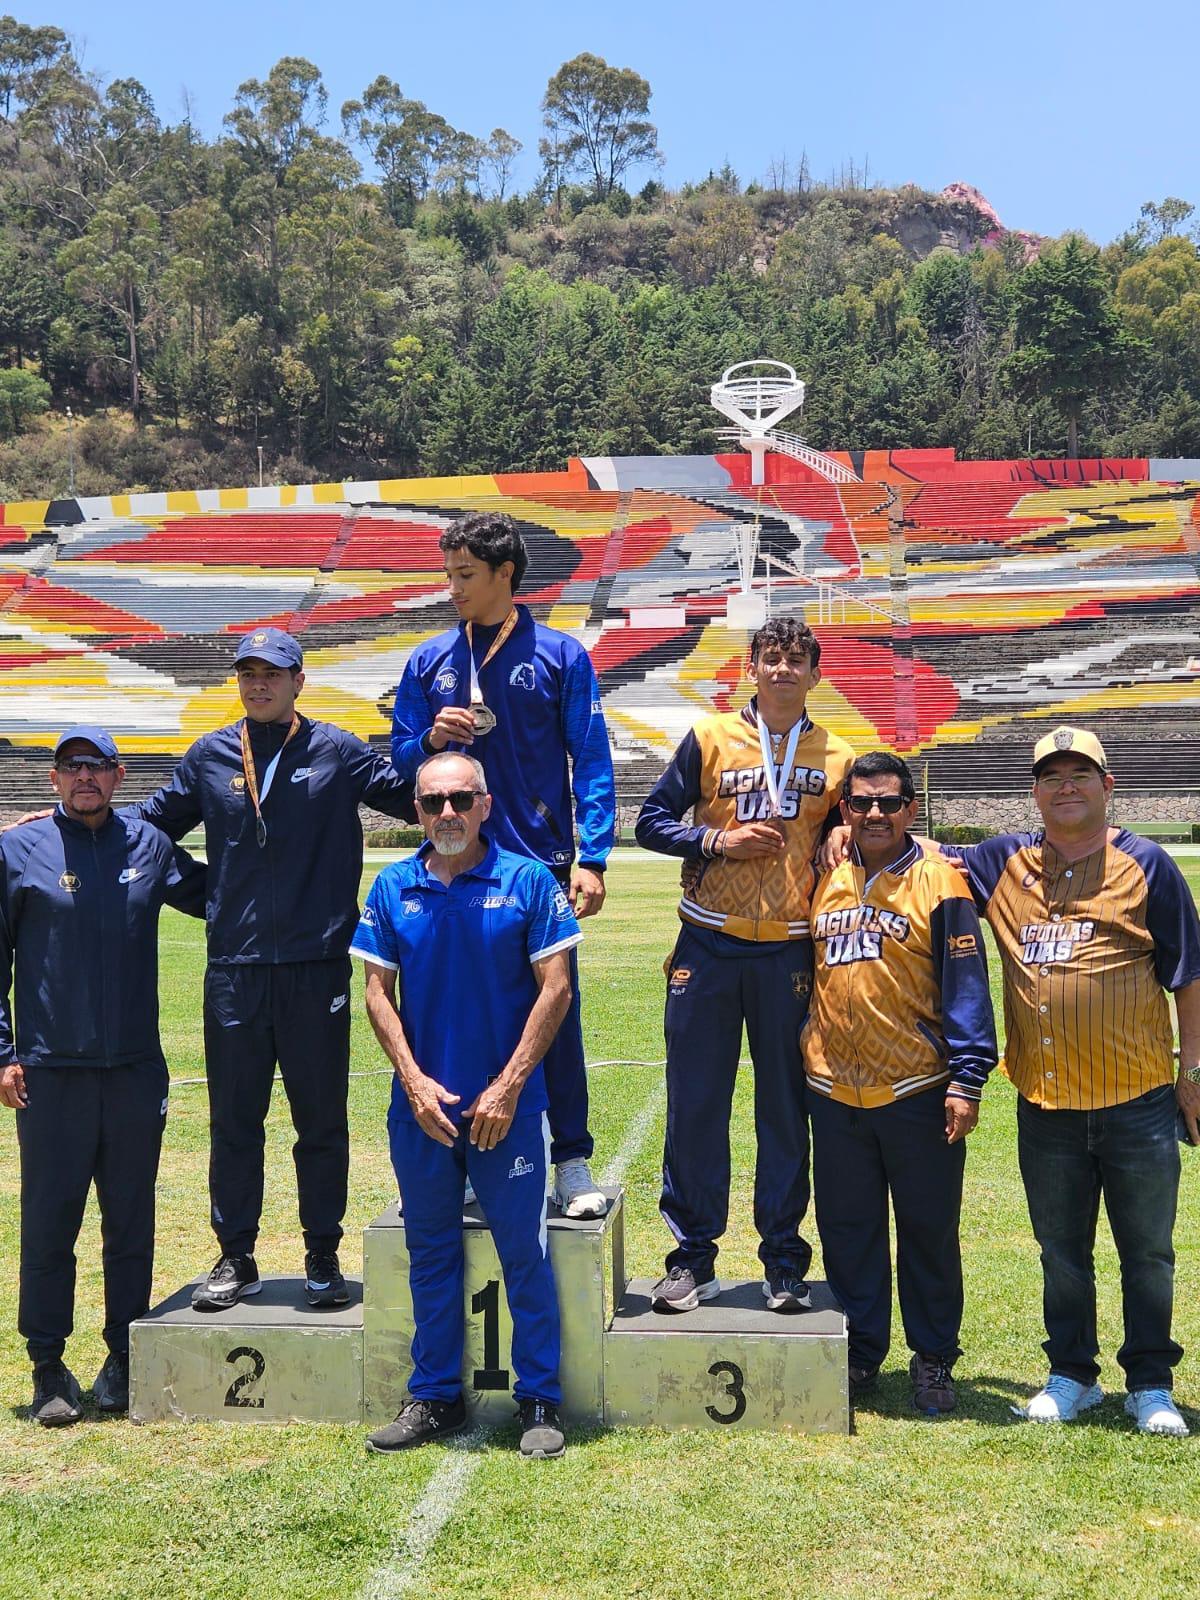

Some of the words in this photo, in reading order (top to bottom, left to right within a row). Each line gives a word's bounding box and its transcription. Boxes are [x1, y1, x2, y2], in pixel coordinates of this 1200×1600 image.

[294, 767, 312, 777] NIKE
[469, 896, 516, 907] POTROS
[814, 904, 910, 942] AGUILAS
[1020, 921, 1095, 945] AGUILAS
[825, 930, 882, 966] UAS
[1022, 941, 1073, 964] UAS
[471, 1279, 509, 1390] 1
[224, 1346, 266, 1408] 2
[705, 1361, 747, 1425] 3
